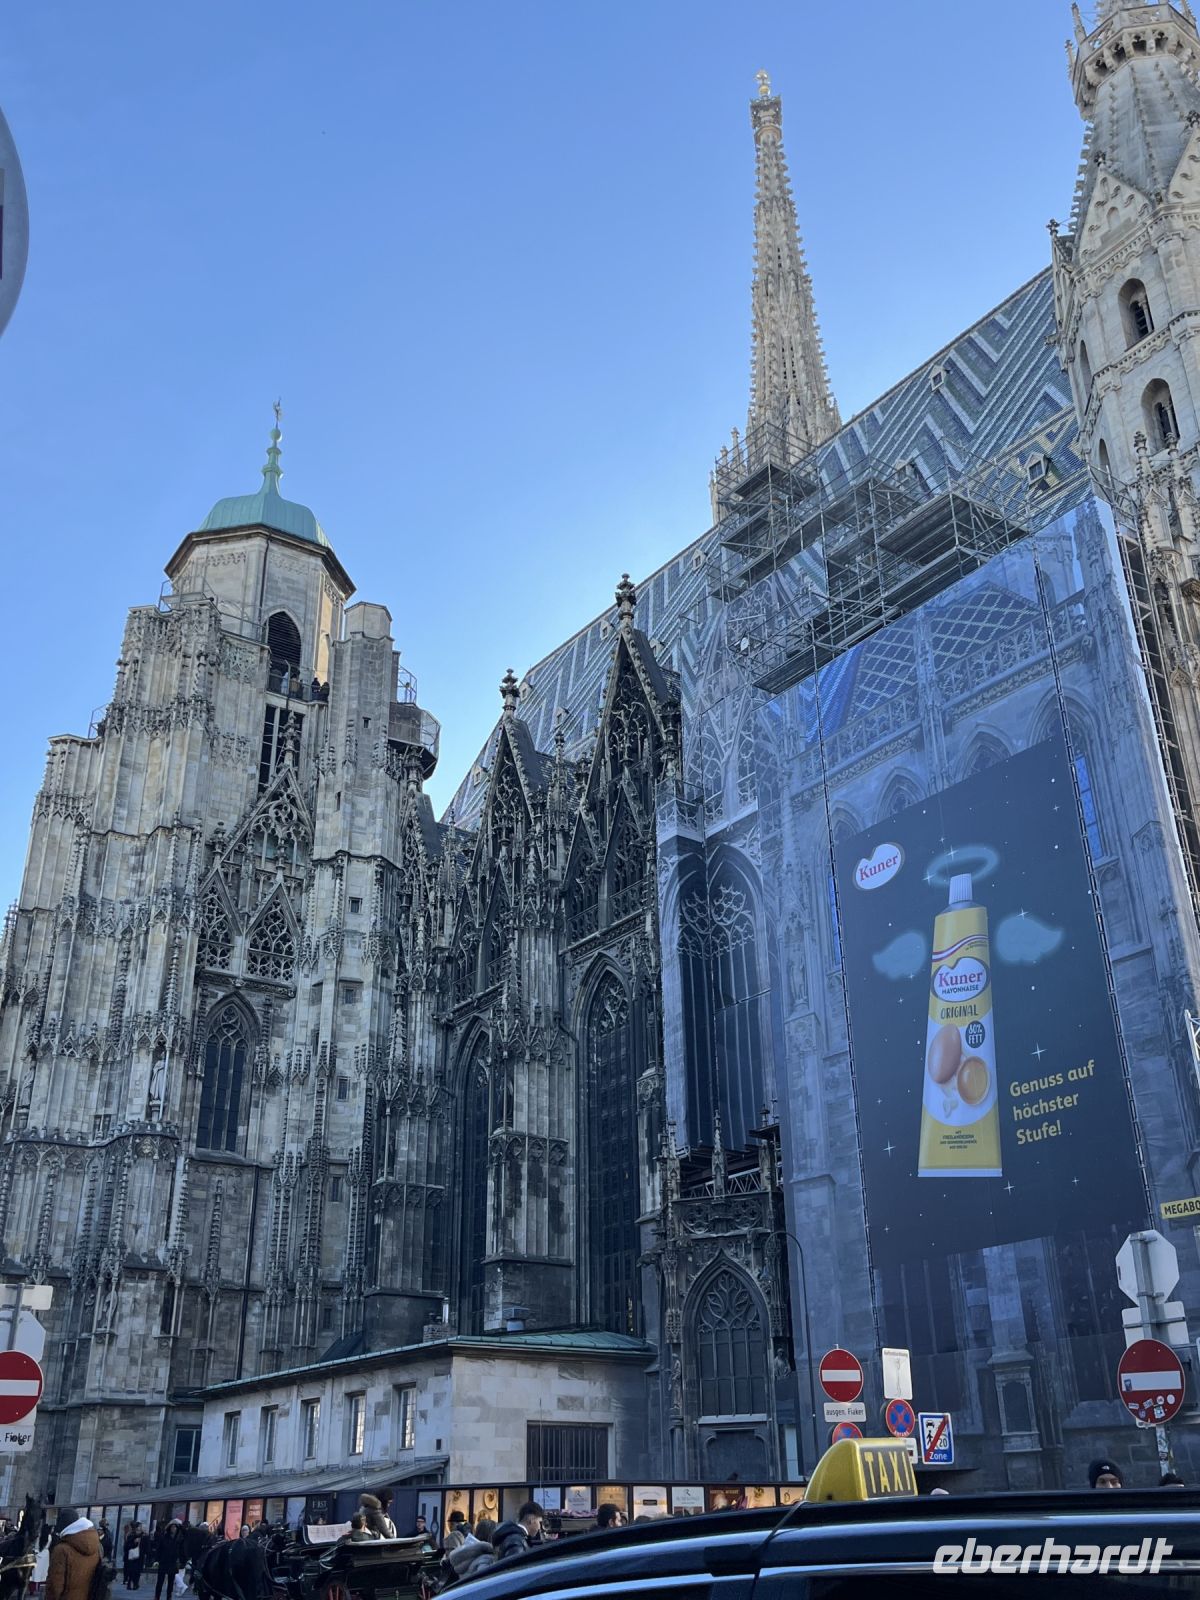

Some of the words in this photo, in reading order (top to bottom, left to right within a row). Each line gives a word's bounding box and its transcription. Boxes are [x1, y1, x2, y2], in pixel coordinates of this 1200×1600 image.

[859, 853, 898, 881] Kuner
[938, 972, 983, 987] Kuner
[941, 984, 979, 994] MAYONNAISE
[940, 1004, 978, 1020] ORIGINAL
[968, 1024, 982, 1034] 80%
[968, 1034, 982, 1044] FETT
[1010, 1073, 1063, 1097] Genuss
[1068, 1059, 1095, 1081] auf
[1013, 1093, 1079, 1121] höchster
[1016, 1119, 1062, 1145] Stufe!
[847, 1407, 864, 1416] Fiaker
[929, 1451, 947, 1460] Zone
[864, 1451, 911, 1494] TAXI
